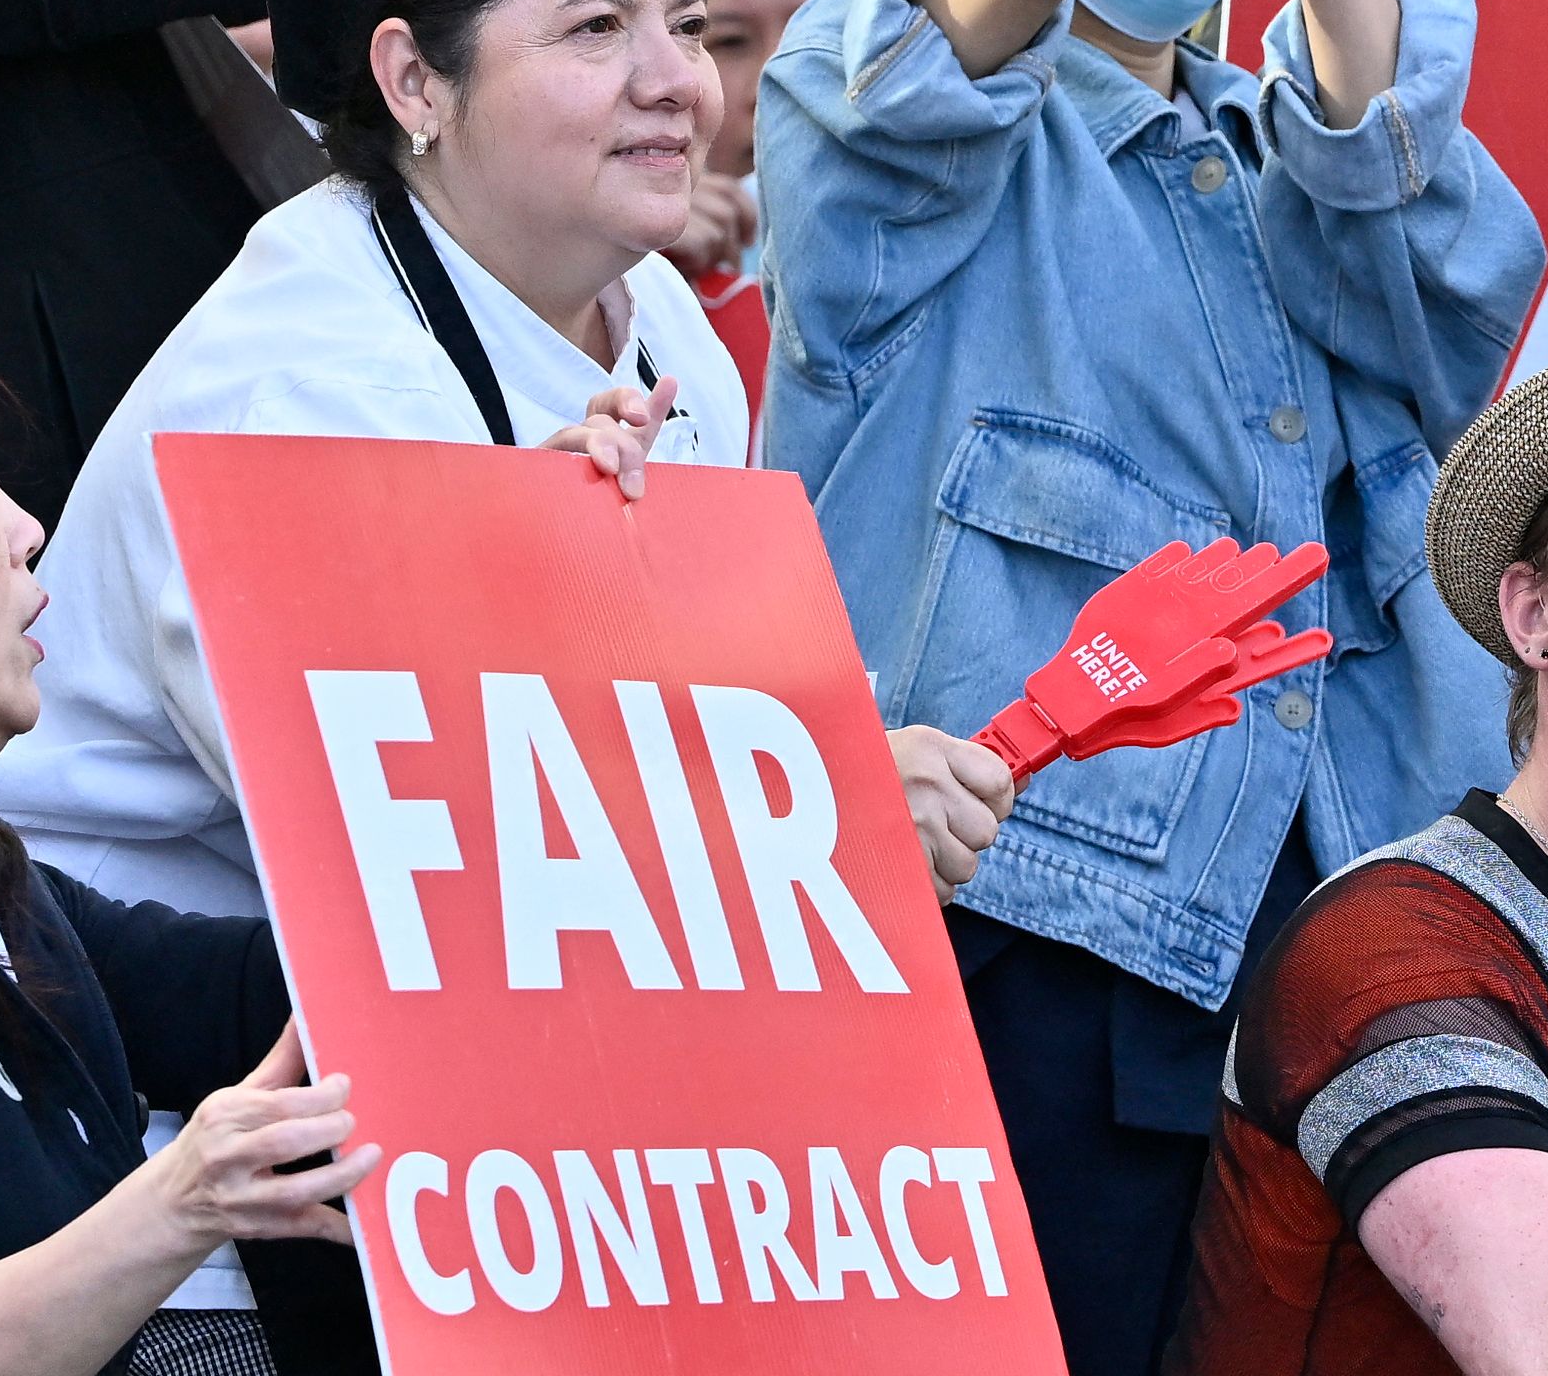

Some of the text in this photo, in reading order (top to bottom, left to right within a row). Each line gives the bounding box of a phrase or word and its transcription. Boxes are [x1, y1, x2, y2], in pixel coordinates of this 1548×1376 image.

[1069, 643, 1130, 704] HERE!
[1089, 630, 1149, 693] UNITE
[303, 669, 910, 996] FAIR
[383, 1145, 1009, 1316] CONTRACT
